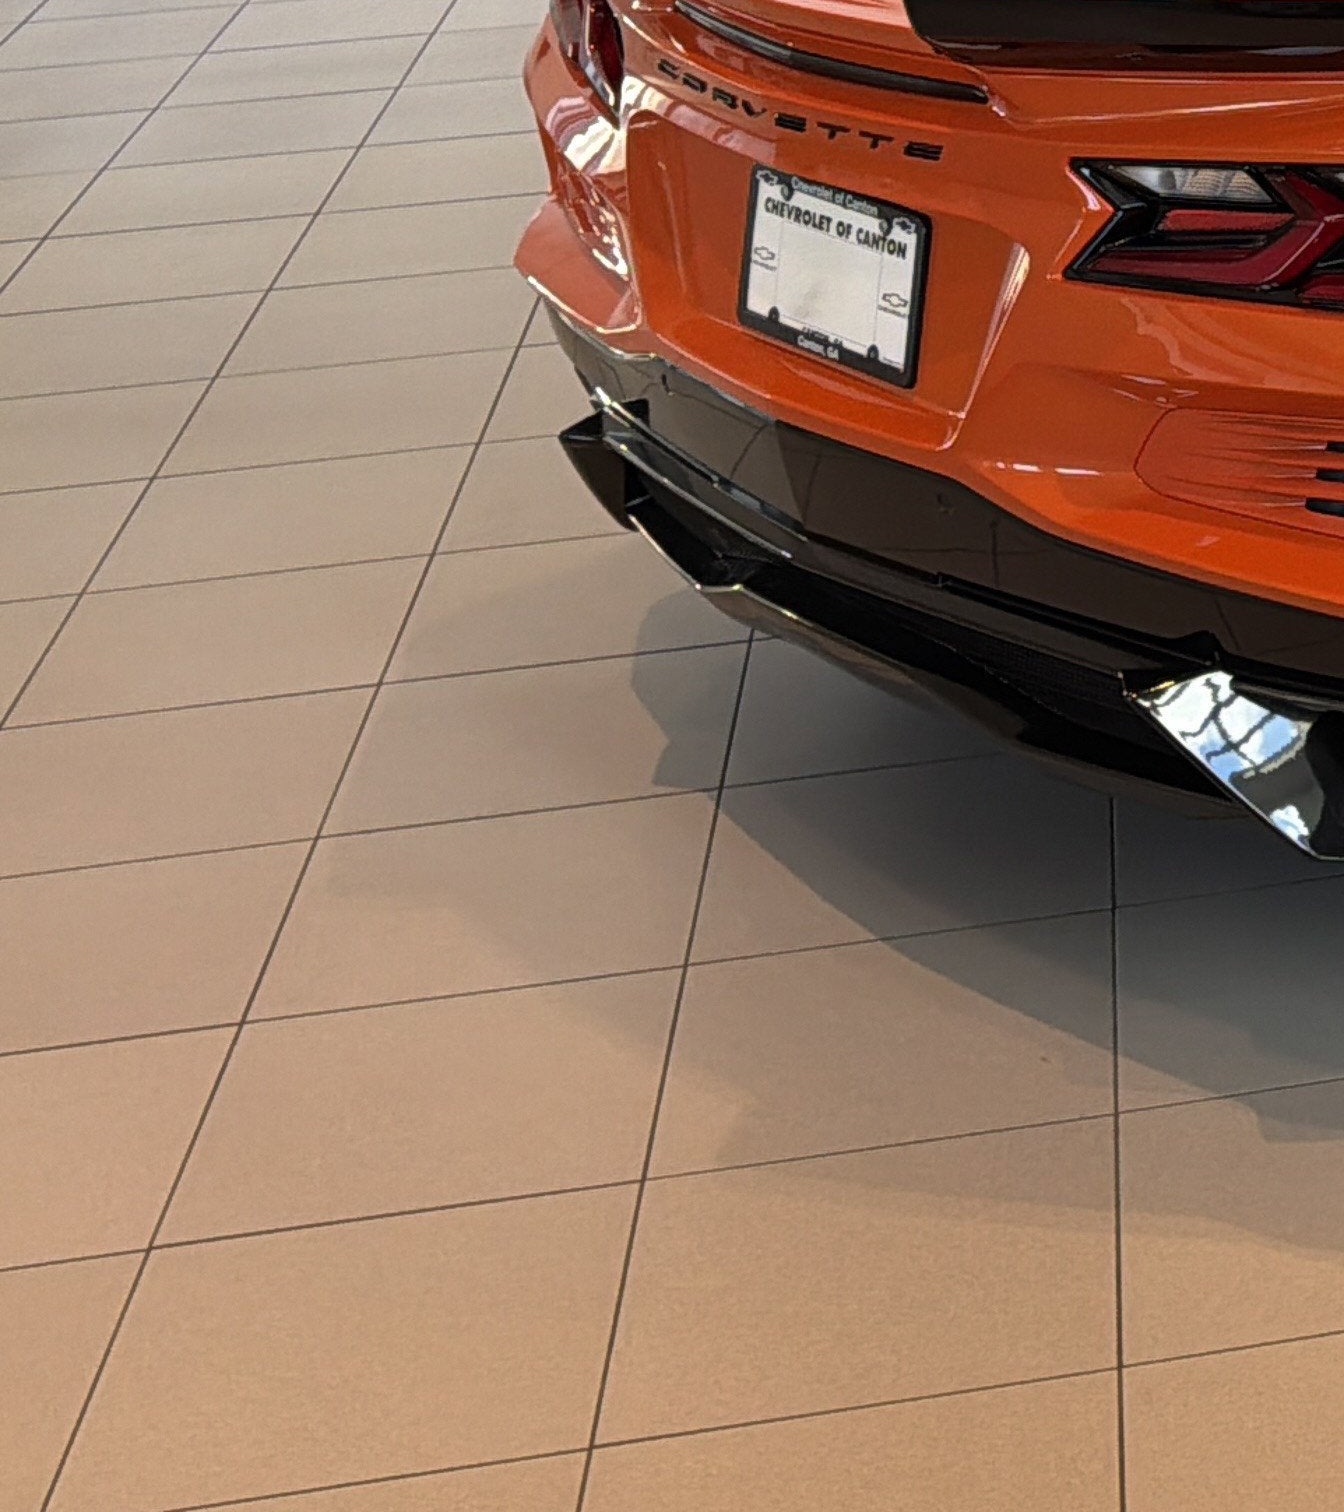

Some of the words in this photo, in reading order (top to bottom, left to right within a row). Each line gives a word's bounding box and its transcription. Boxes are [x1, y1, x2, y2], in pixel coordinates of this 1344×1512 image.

[657, 58, 944, 162] CORVETTE
[764, 196, 833, 233] CHEVROLET
[835, 219, 853, 239] OF
[856, 228, 908, 261] CANTON
